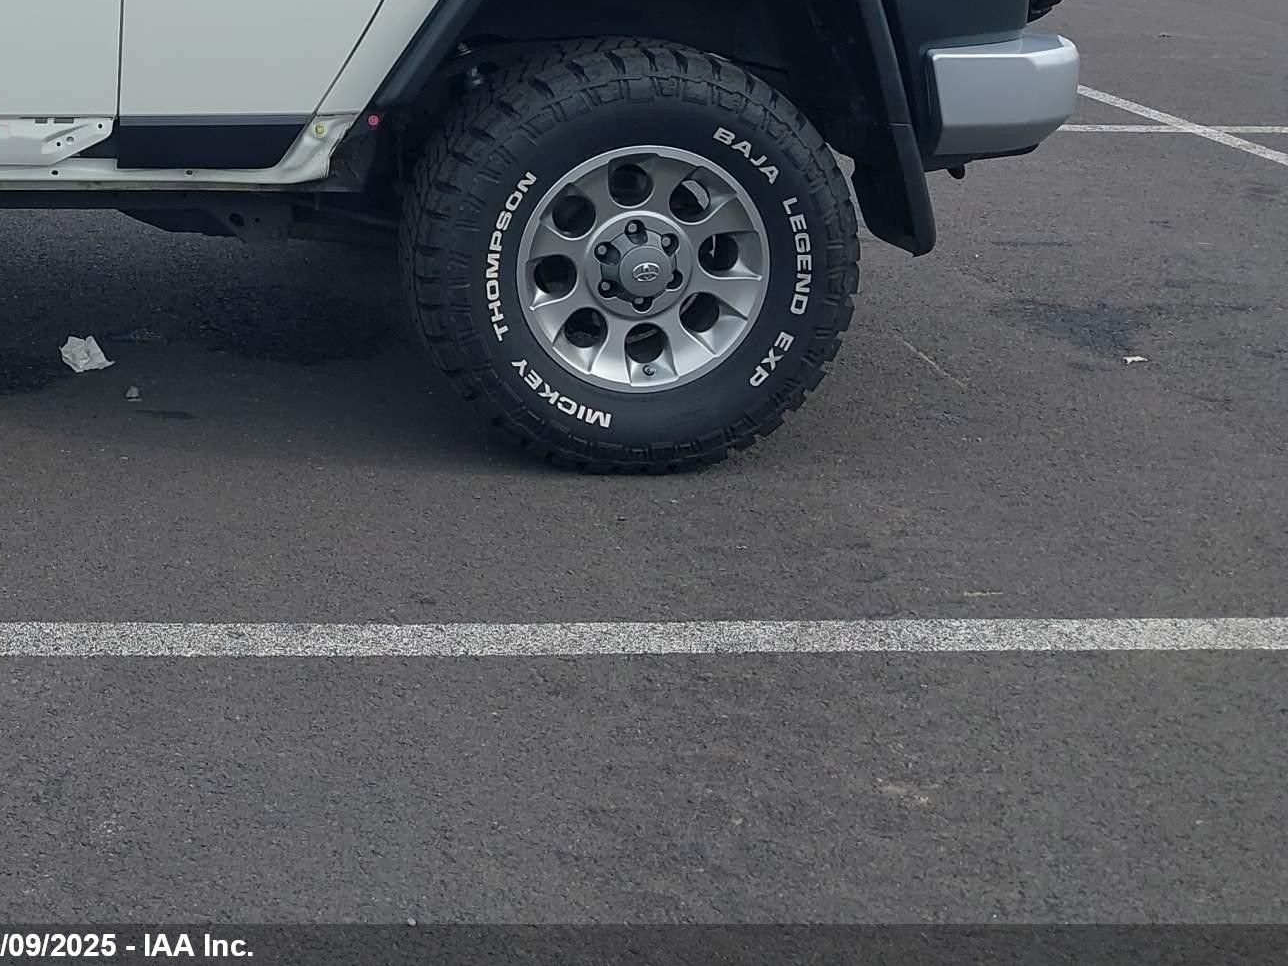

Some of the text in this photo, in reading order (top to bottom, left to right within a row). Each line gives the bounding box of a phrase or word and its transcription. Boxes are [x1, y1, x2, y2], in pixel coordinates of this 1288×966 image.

[485, 172, 612, 429] MICKEY THOMPSON
[712, 127, 811, 388] BAJA LEGEND EXP
